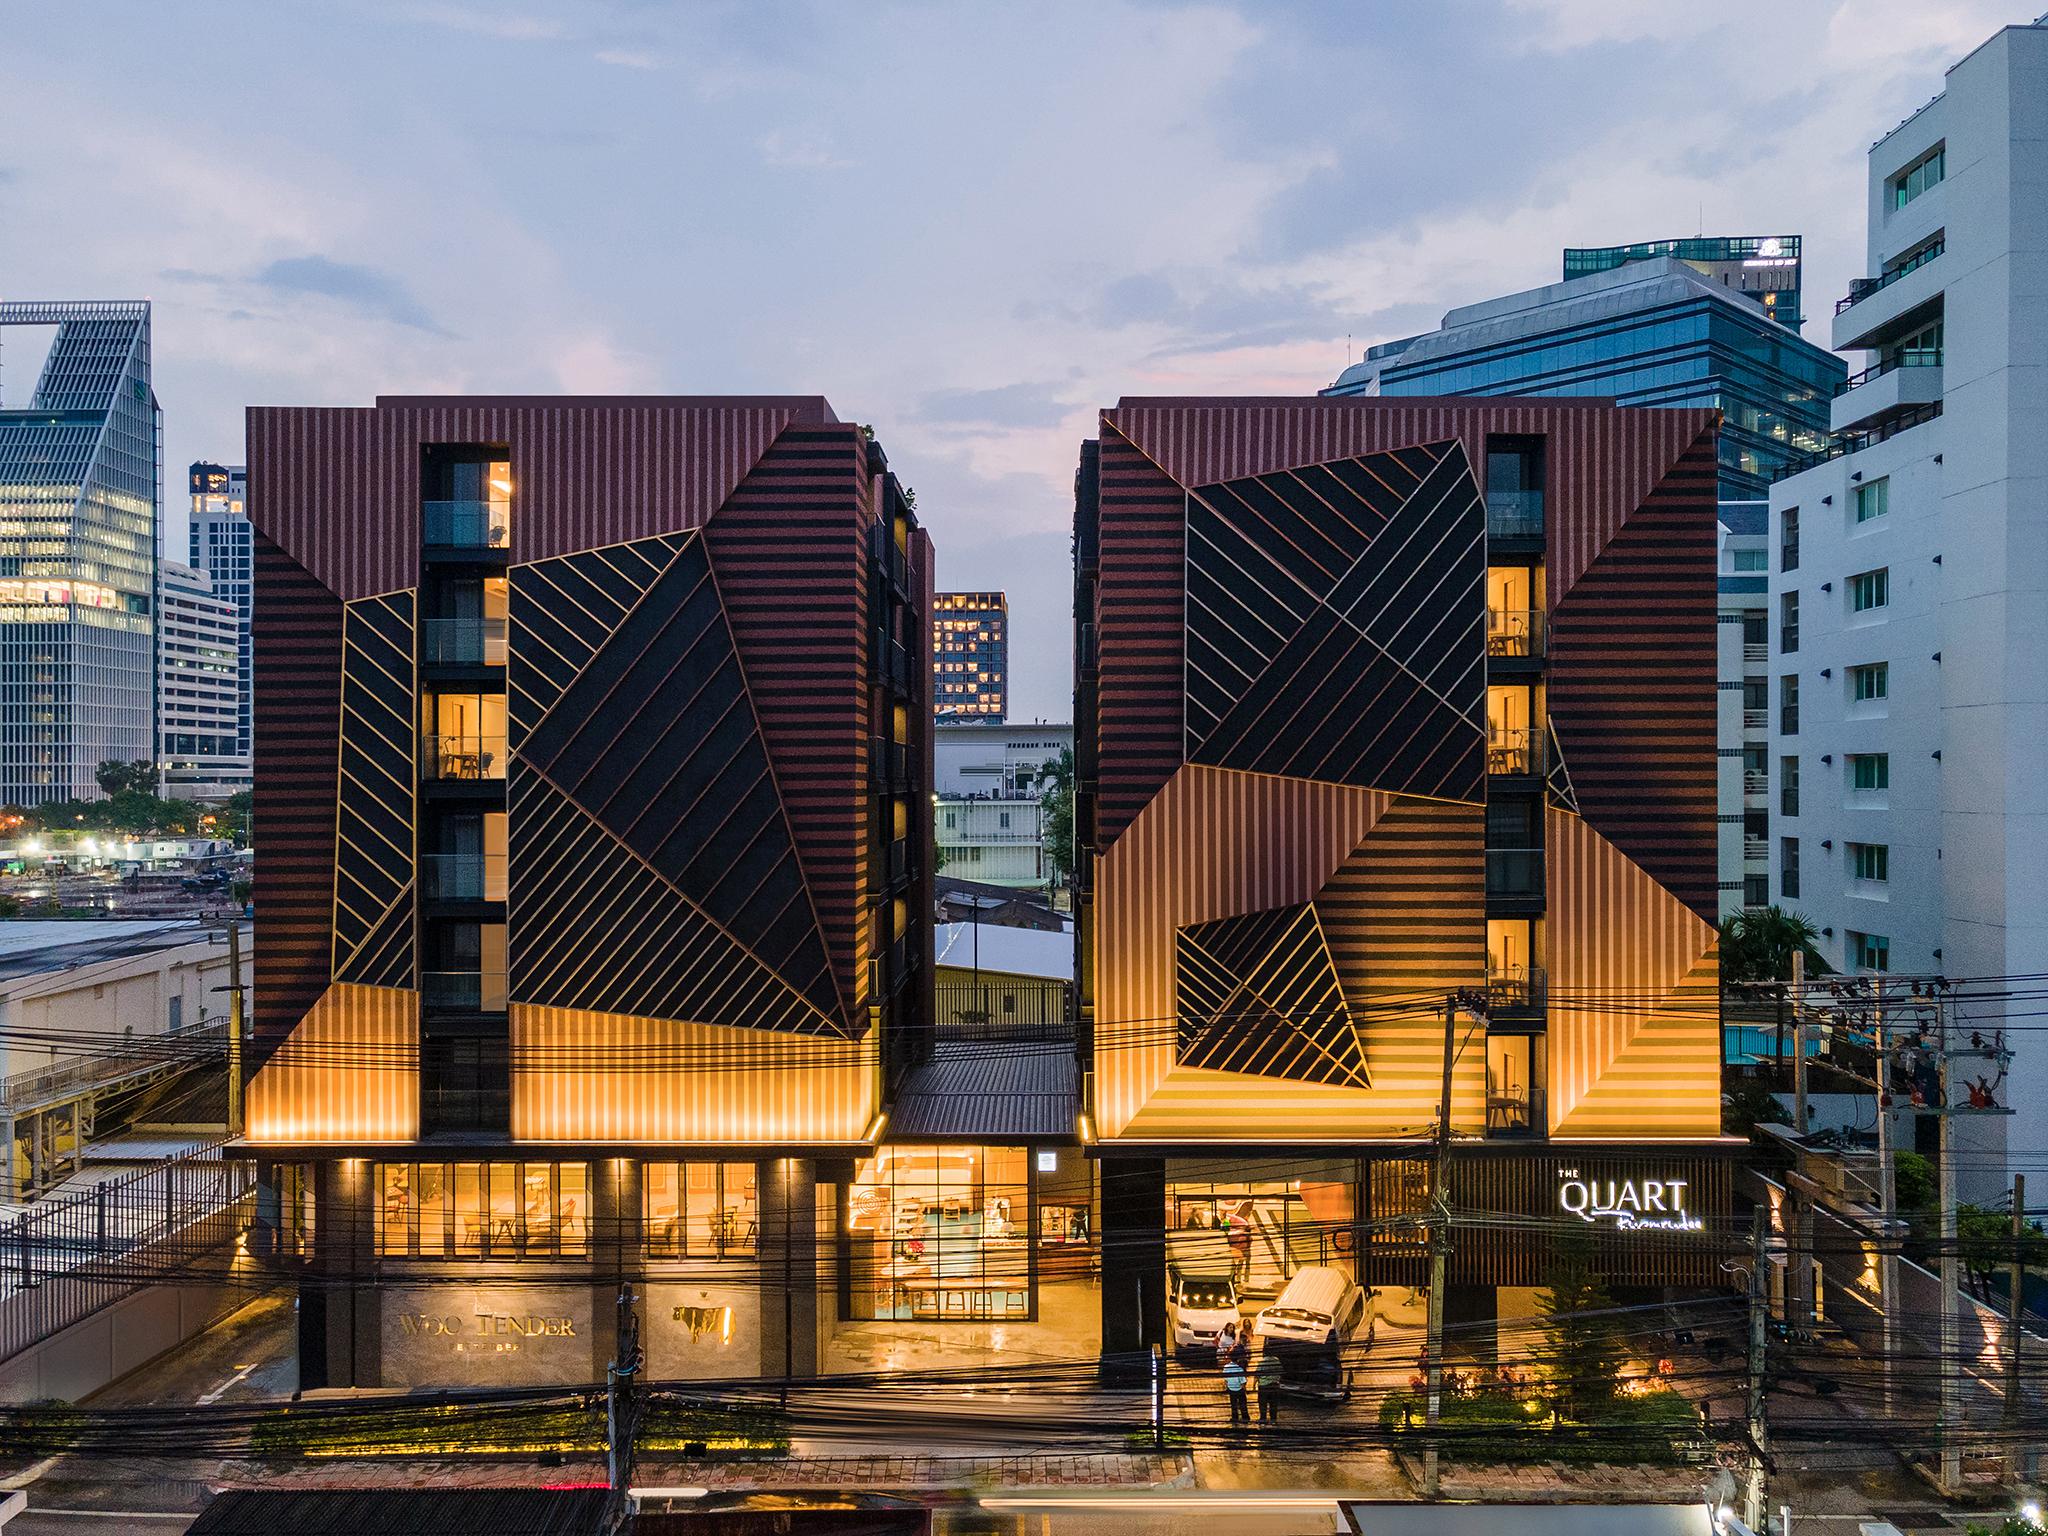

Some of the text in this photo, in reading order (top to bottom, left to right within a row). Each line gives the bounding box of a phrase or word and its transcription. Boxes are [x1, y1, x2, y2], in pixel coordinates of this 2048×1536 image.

[1558, 1169, 1579, 1178] THE
[1560, 1181, 1688, 1222] QUART
[398, 1313, 577, 1337] WOO TENDER
